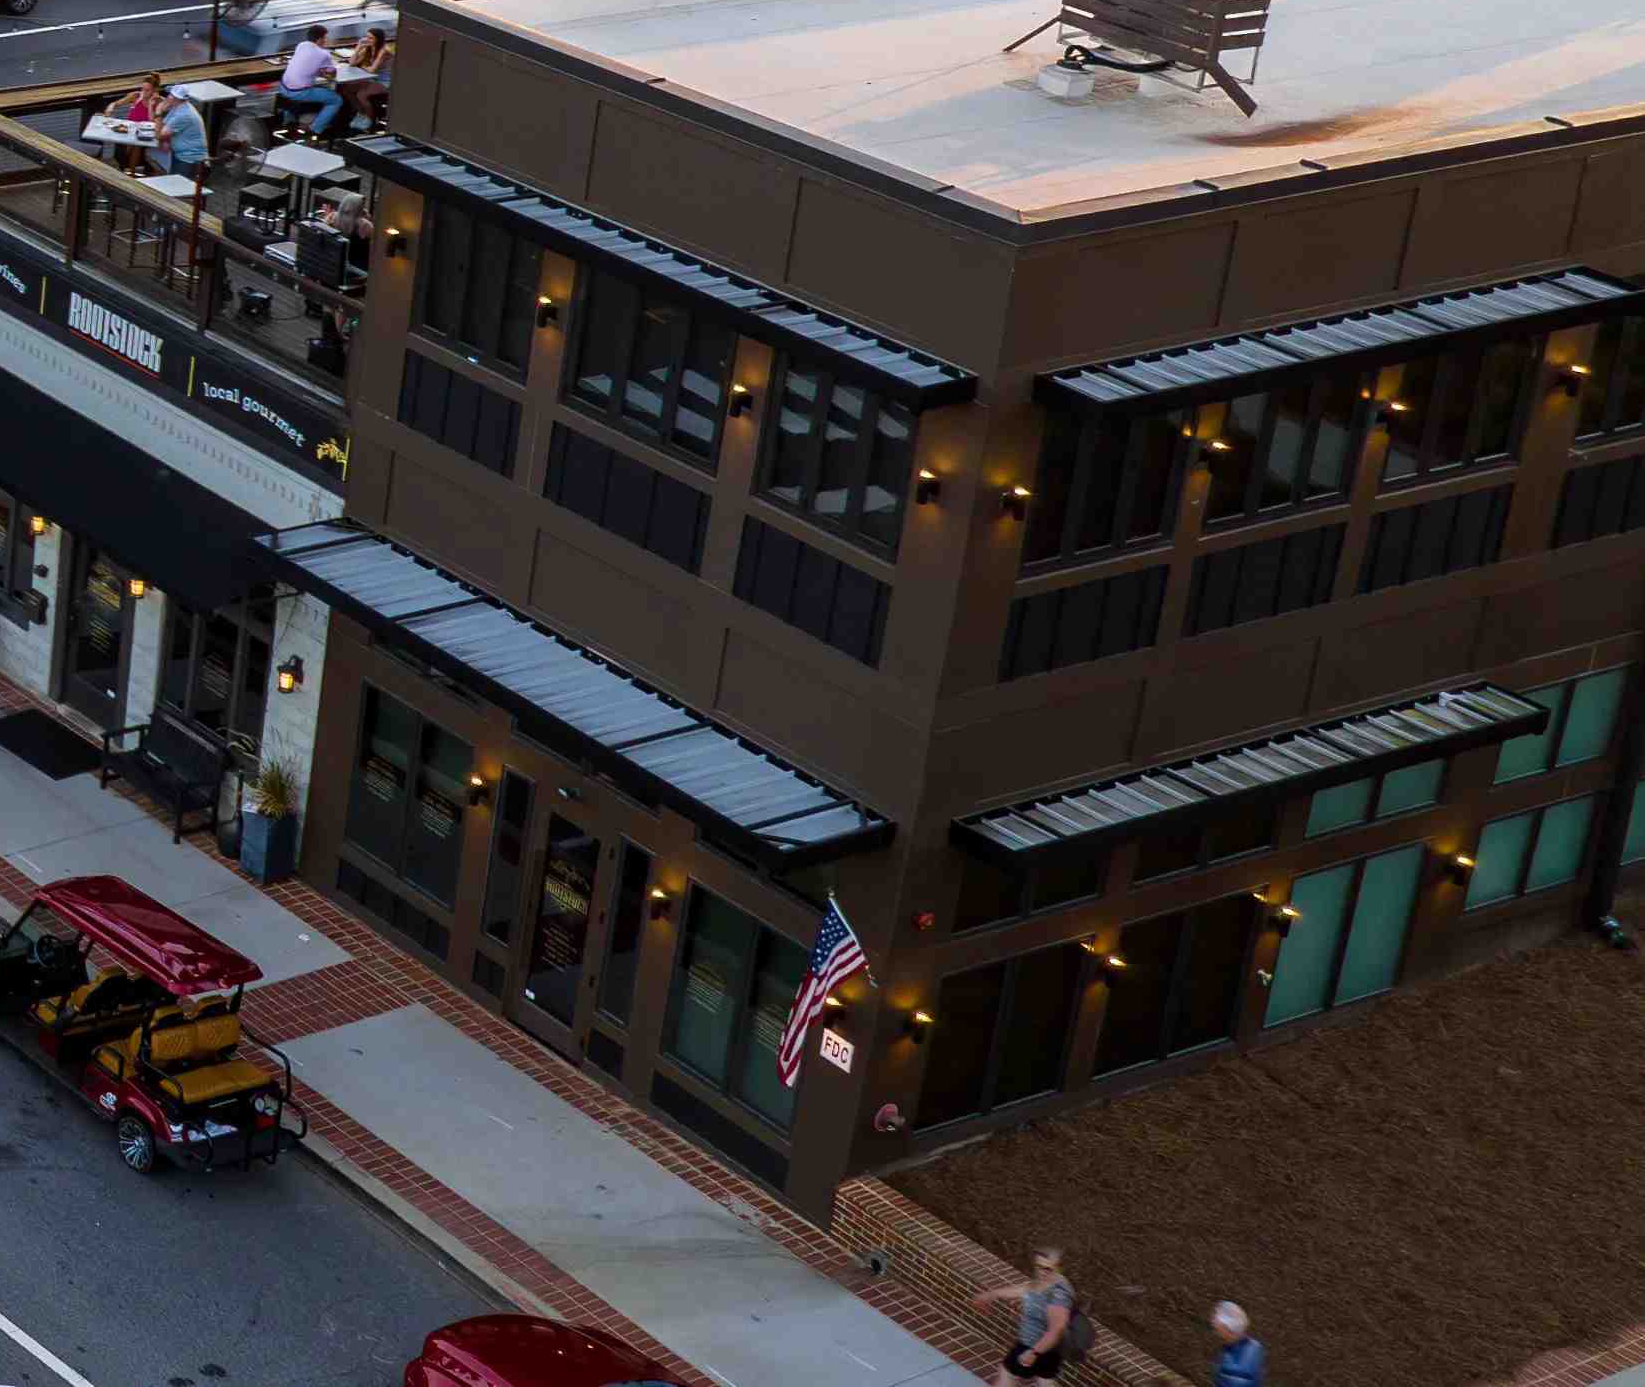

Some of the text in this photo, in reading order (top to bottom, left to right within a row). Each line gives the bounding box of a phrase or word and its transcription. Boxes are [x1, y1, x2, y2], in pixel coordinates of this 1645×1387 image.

[69, 292, 164, 373] ROOTSTOCK
[202, 381, 307, 448] local gourmet
[824, 1035, 849, 1064] FDC
